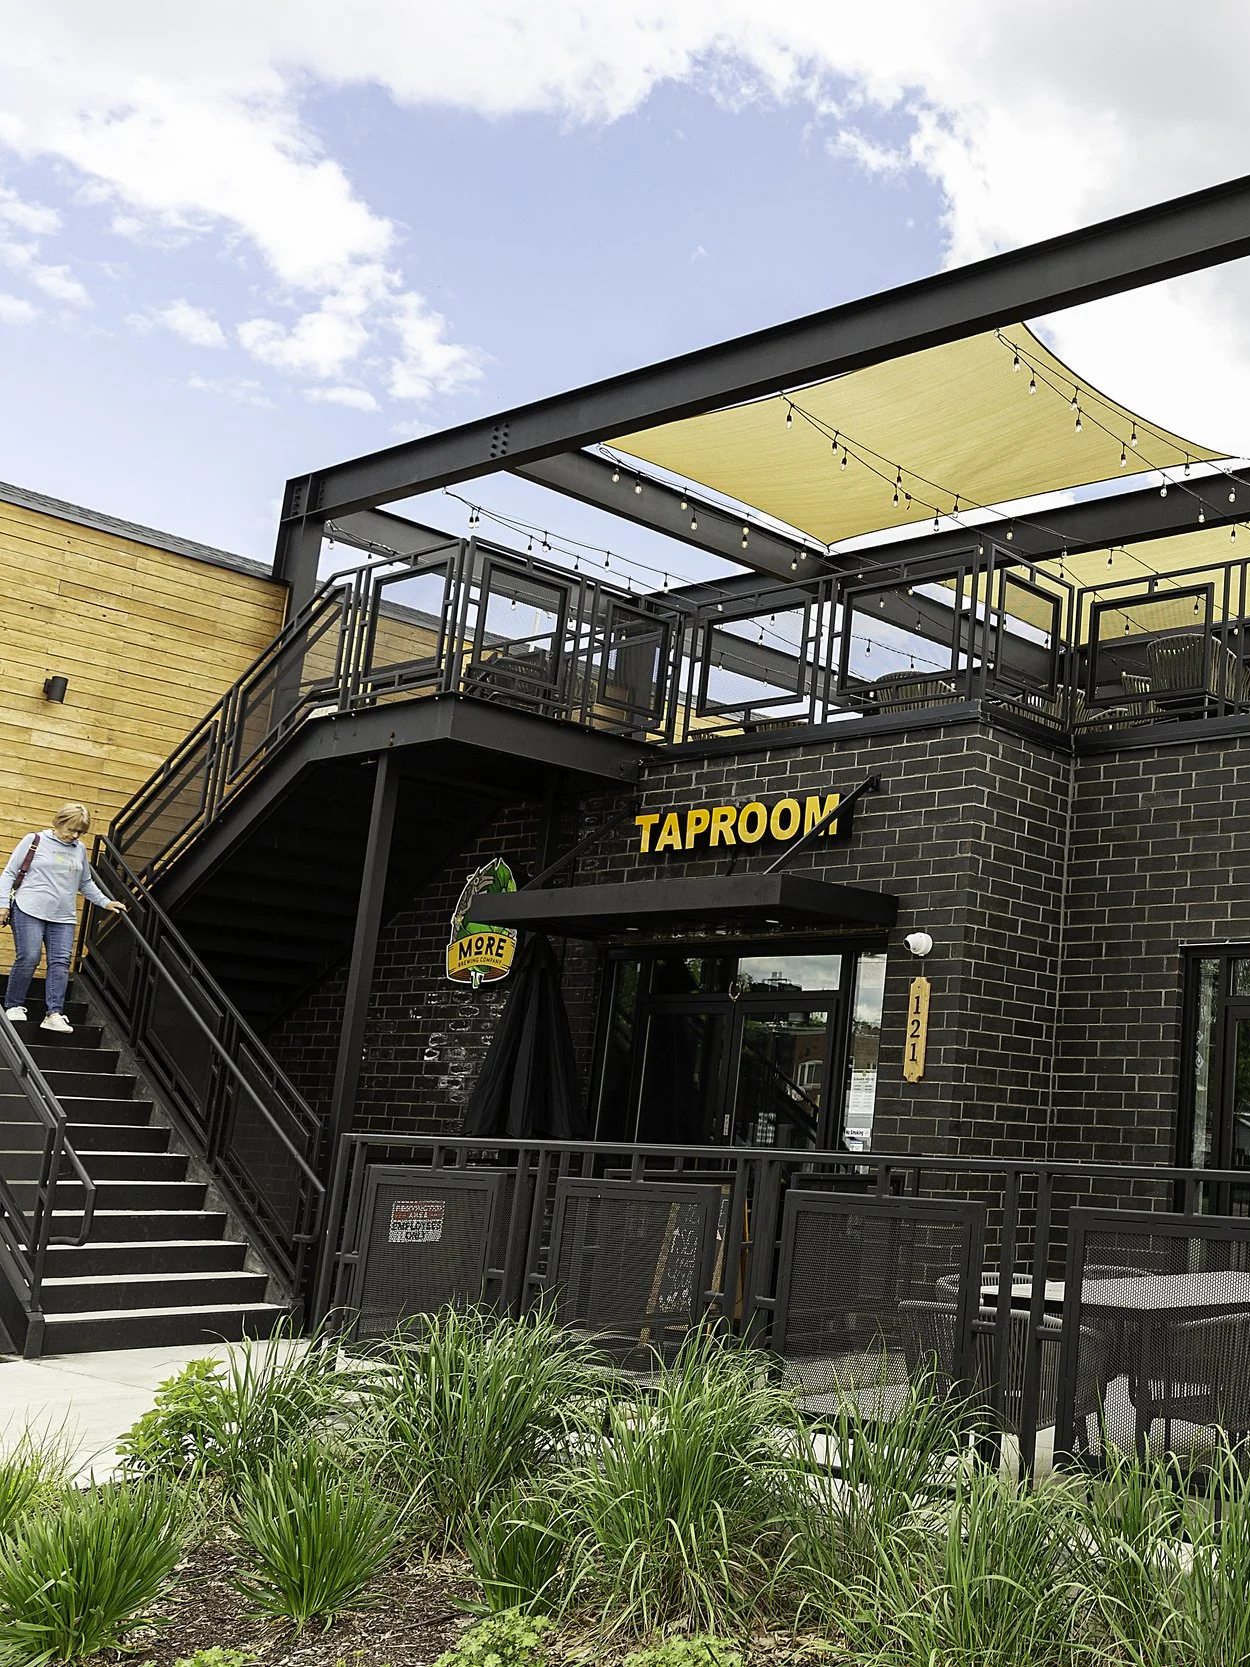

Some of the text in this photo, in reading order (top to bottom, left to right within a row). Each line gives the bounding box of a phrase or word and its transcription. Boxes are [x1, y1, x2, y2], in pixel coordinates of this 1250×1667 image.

[635, 793, 841, 853] TAPROOM
[458, 936, 507, 960] MORE
[458, 956, 502, 967] BREWING COMPANY
[909, 996, 921, 1061] 121
[390, 1221, 441, 1230] EMPLOYEES
[405, 1231, 425, 1240] ONLY
